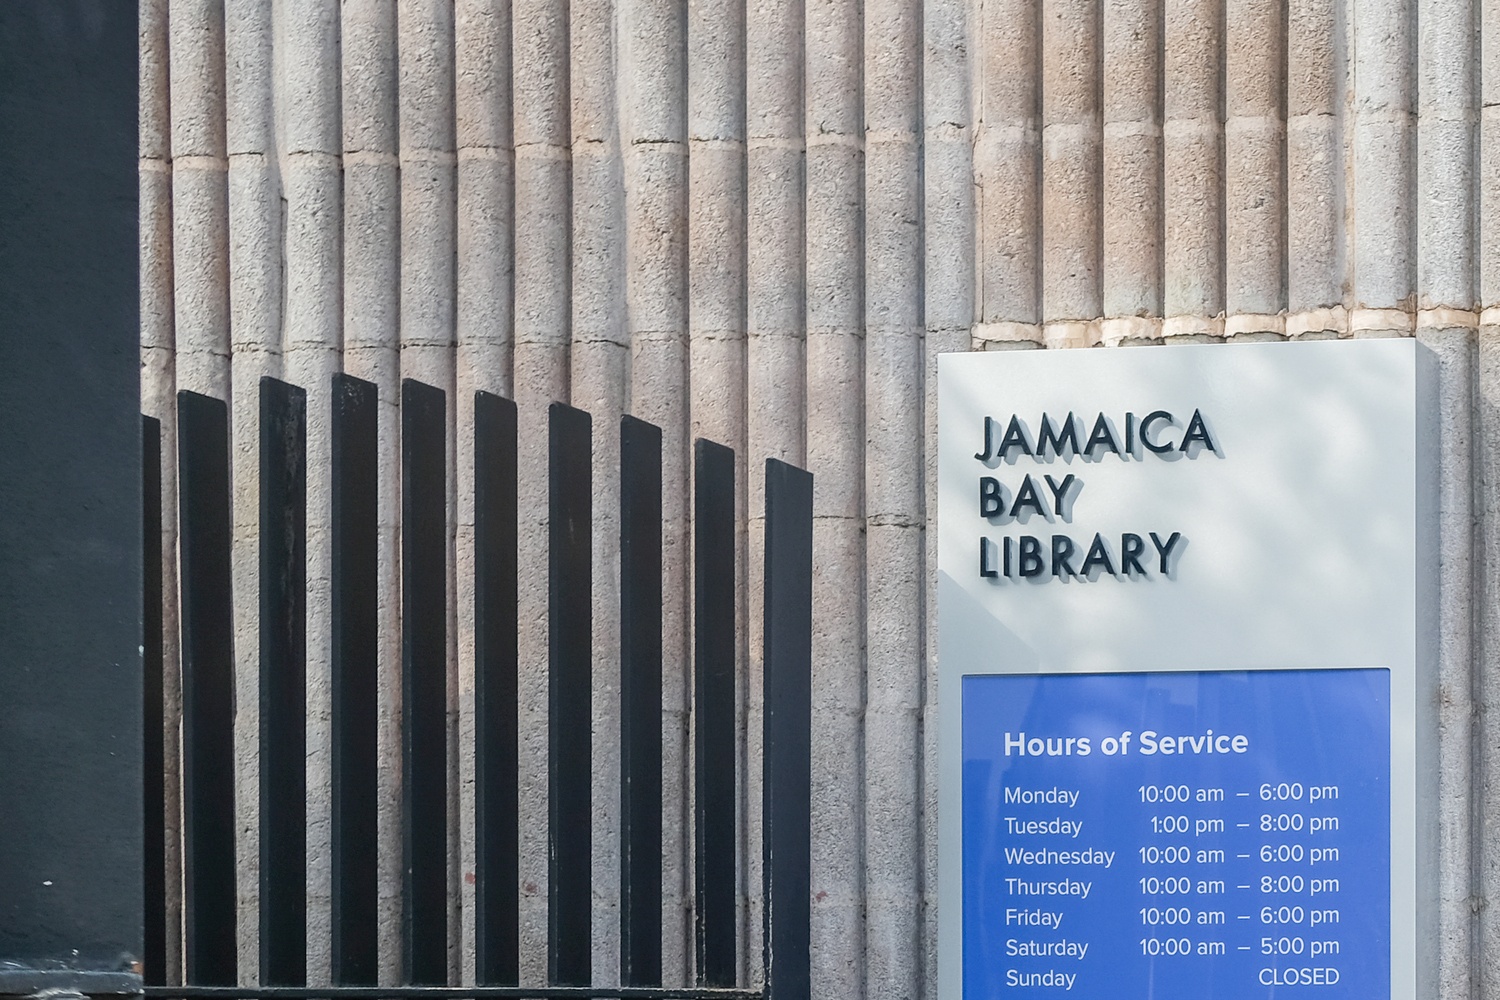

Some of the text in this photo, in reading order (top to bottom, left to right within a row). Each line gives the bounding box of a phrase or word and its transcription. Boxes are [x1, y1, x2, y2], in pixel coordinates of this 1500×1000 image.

[975, 408, 1215, 461] JAMAICA
[980, 474, 1075, 518] BAY
[980, 532, 1181, 577] LIBRARY
[1004, 730, 1249, 756] Hours of Service
[1004, 787, 1080, 807] Monday
[1138, 785, 1190, 802] 10:00
[1196, 789, 1224, 802] am
[1259, 783, 1303, 800] 6:00
[1309, 786, 1339, 803] pm
[1004, 818, 1082, 837] Tuesday
[1151, 816, 1190, 833] 1:00
[1196, 819, 1225, 836] pm
[1260, 814, 1303, 831] 8:00
[1310, 817, 1339, 834] pm
[1004, 848, 1115, 868] Wednesday
[1139, 847, 1190, 864] 10:00
[1196, 850, 1225, 863] am
[1260, 845, 1303, 862] 6:00
[1310, 848, 1339, 865] pm
[1005, 878, 1092, 898] Thursday
[1139, 877, 1190, 895] 10:00
[1196, 881, 1225, 894] am
[1260, 875, 1303, 893] 8:00
[1310, 878, 1339, 896] pm
[1005, 909, 1063, 929] Friday
[1139, 908, 1190, 925] 10:00
[1196, 912, 1225, 925] am
[1260, 906, 1303, 924] 6:00
[1310, 909, 1340, 926] pm
[1006, 940, 1088, 959] Saturday
[1139, 939, 1191, 956] 10:00
[1197, 942, 1225, 955] am
[1260, 937, 1304, 954] 5:00
[1310, 940, 1340, 957] pm
[1006, 968, 1340, 990] Sunday CLOSED
